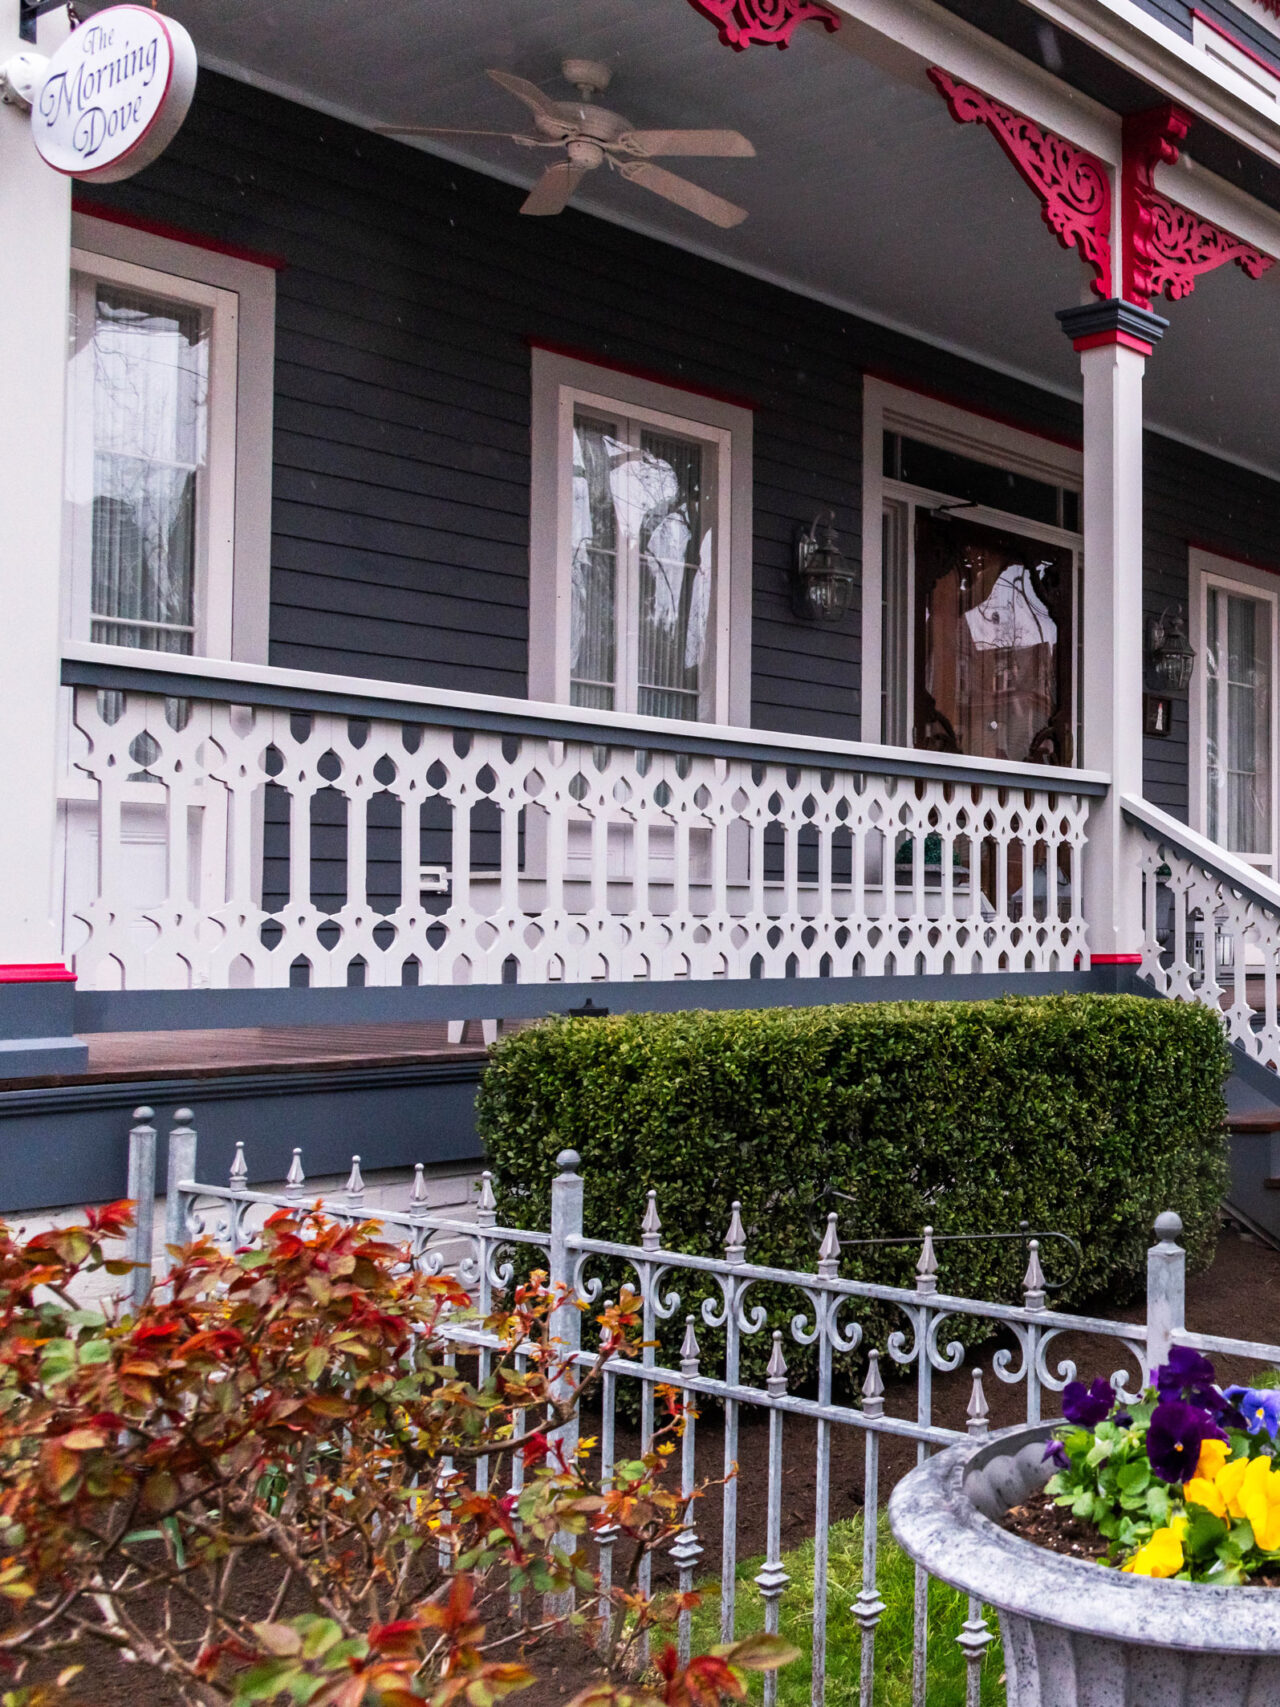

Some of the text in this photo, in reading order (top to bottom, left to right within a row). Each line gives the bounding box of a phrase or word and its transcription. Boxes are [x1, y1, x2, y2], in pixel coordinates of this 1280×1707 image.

[82, 26, 115, 55] The
[39, 38, 158, 127] Morning
[72, 95, 142, 159] Dove
